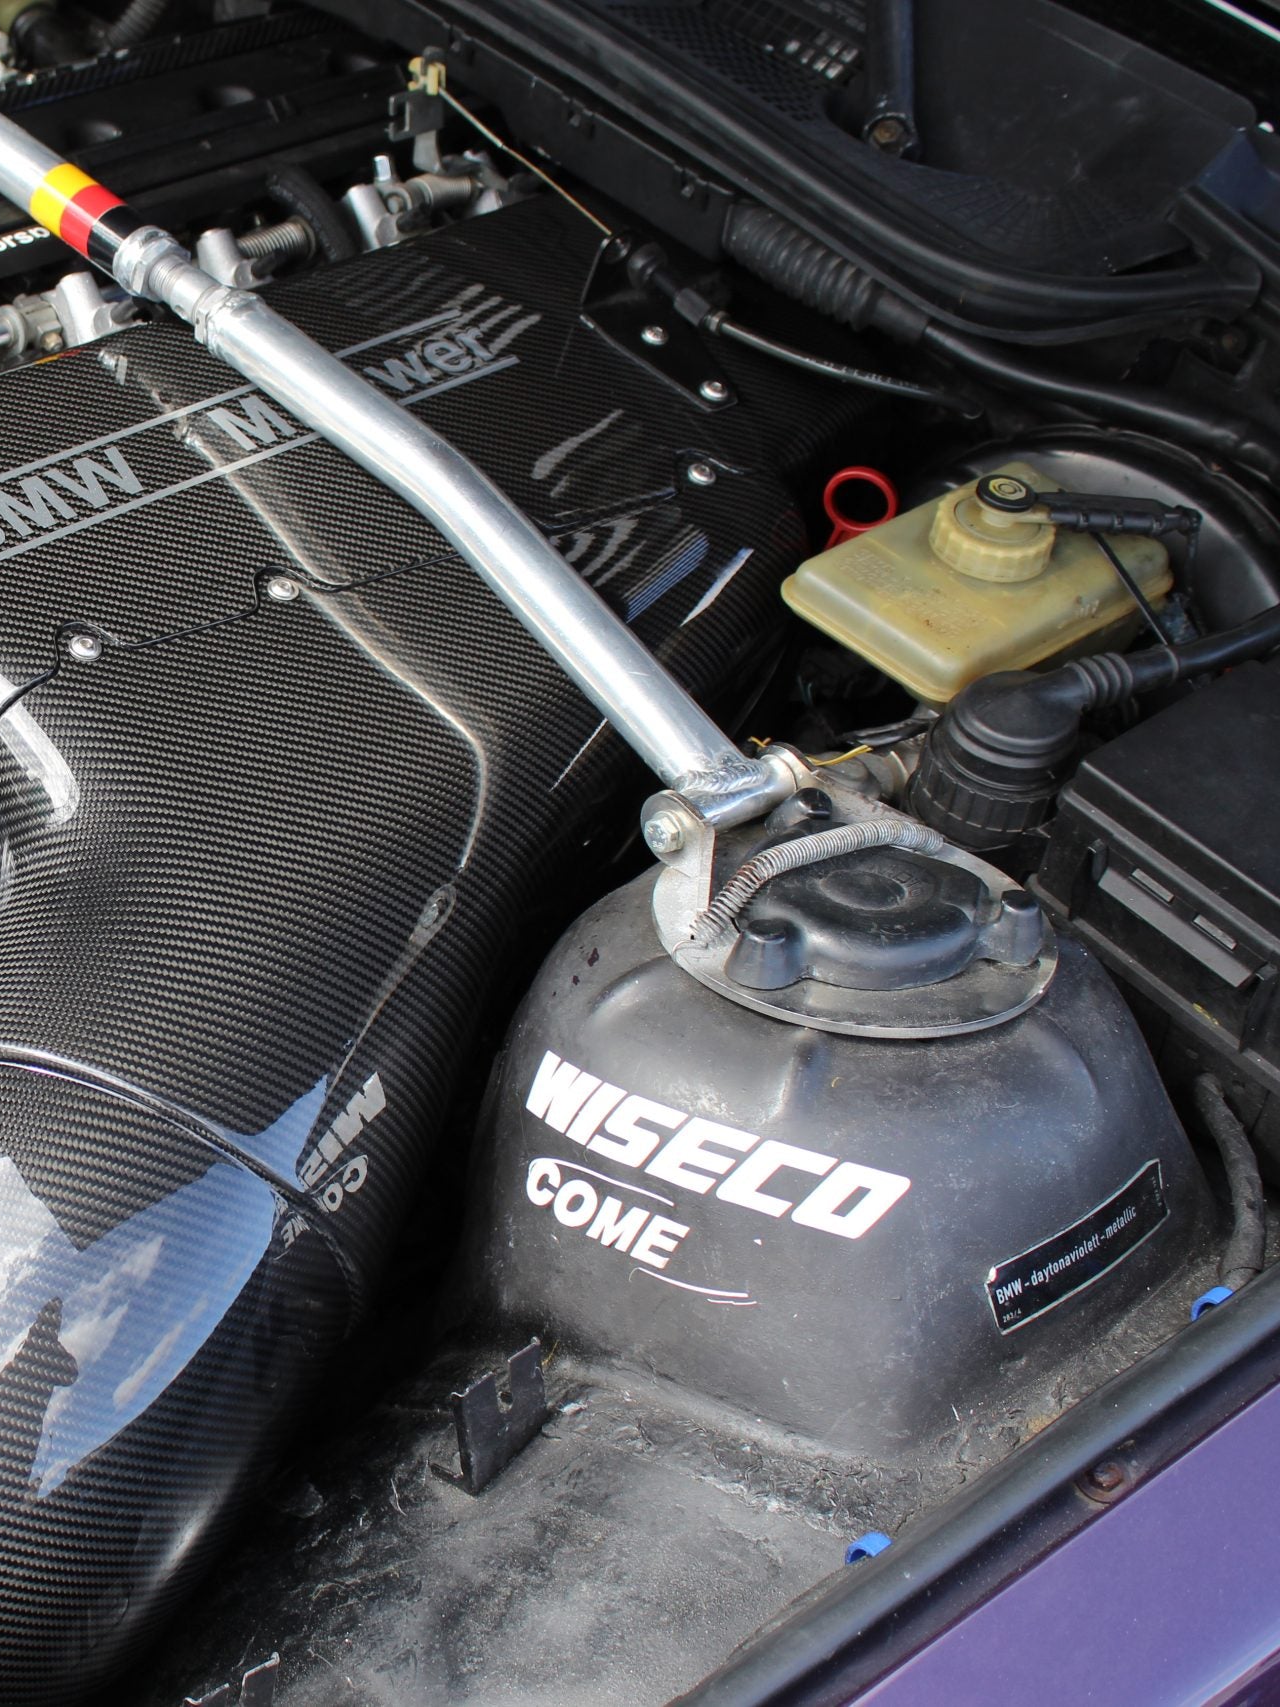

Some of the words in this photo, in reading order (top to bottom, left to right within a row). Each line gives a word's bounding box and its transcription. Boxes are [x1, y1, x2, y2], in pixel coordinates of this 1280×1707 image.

[207, 394, 296, 451] M
[362, 326, 494, 392] wer
[526, 1050, 912, 1240] WISECO
[526, 1160, 691, 1270] COME
